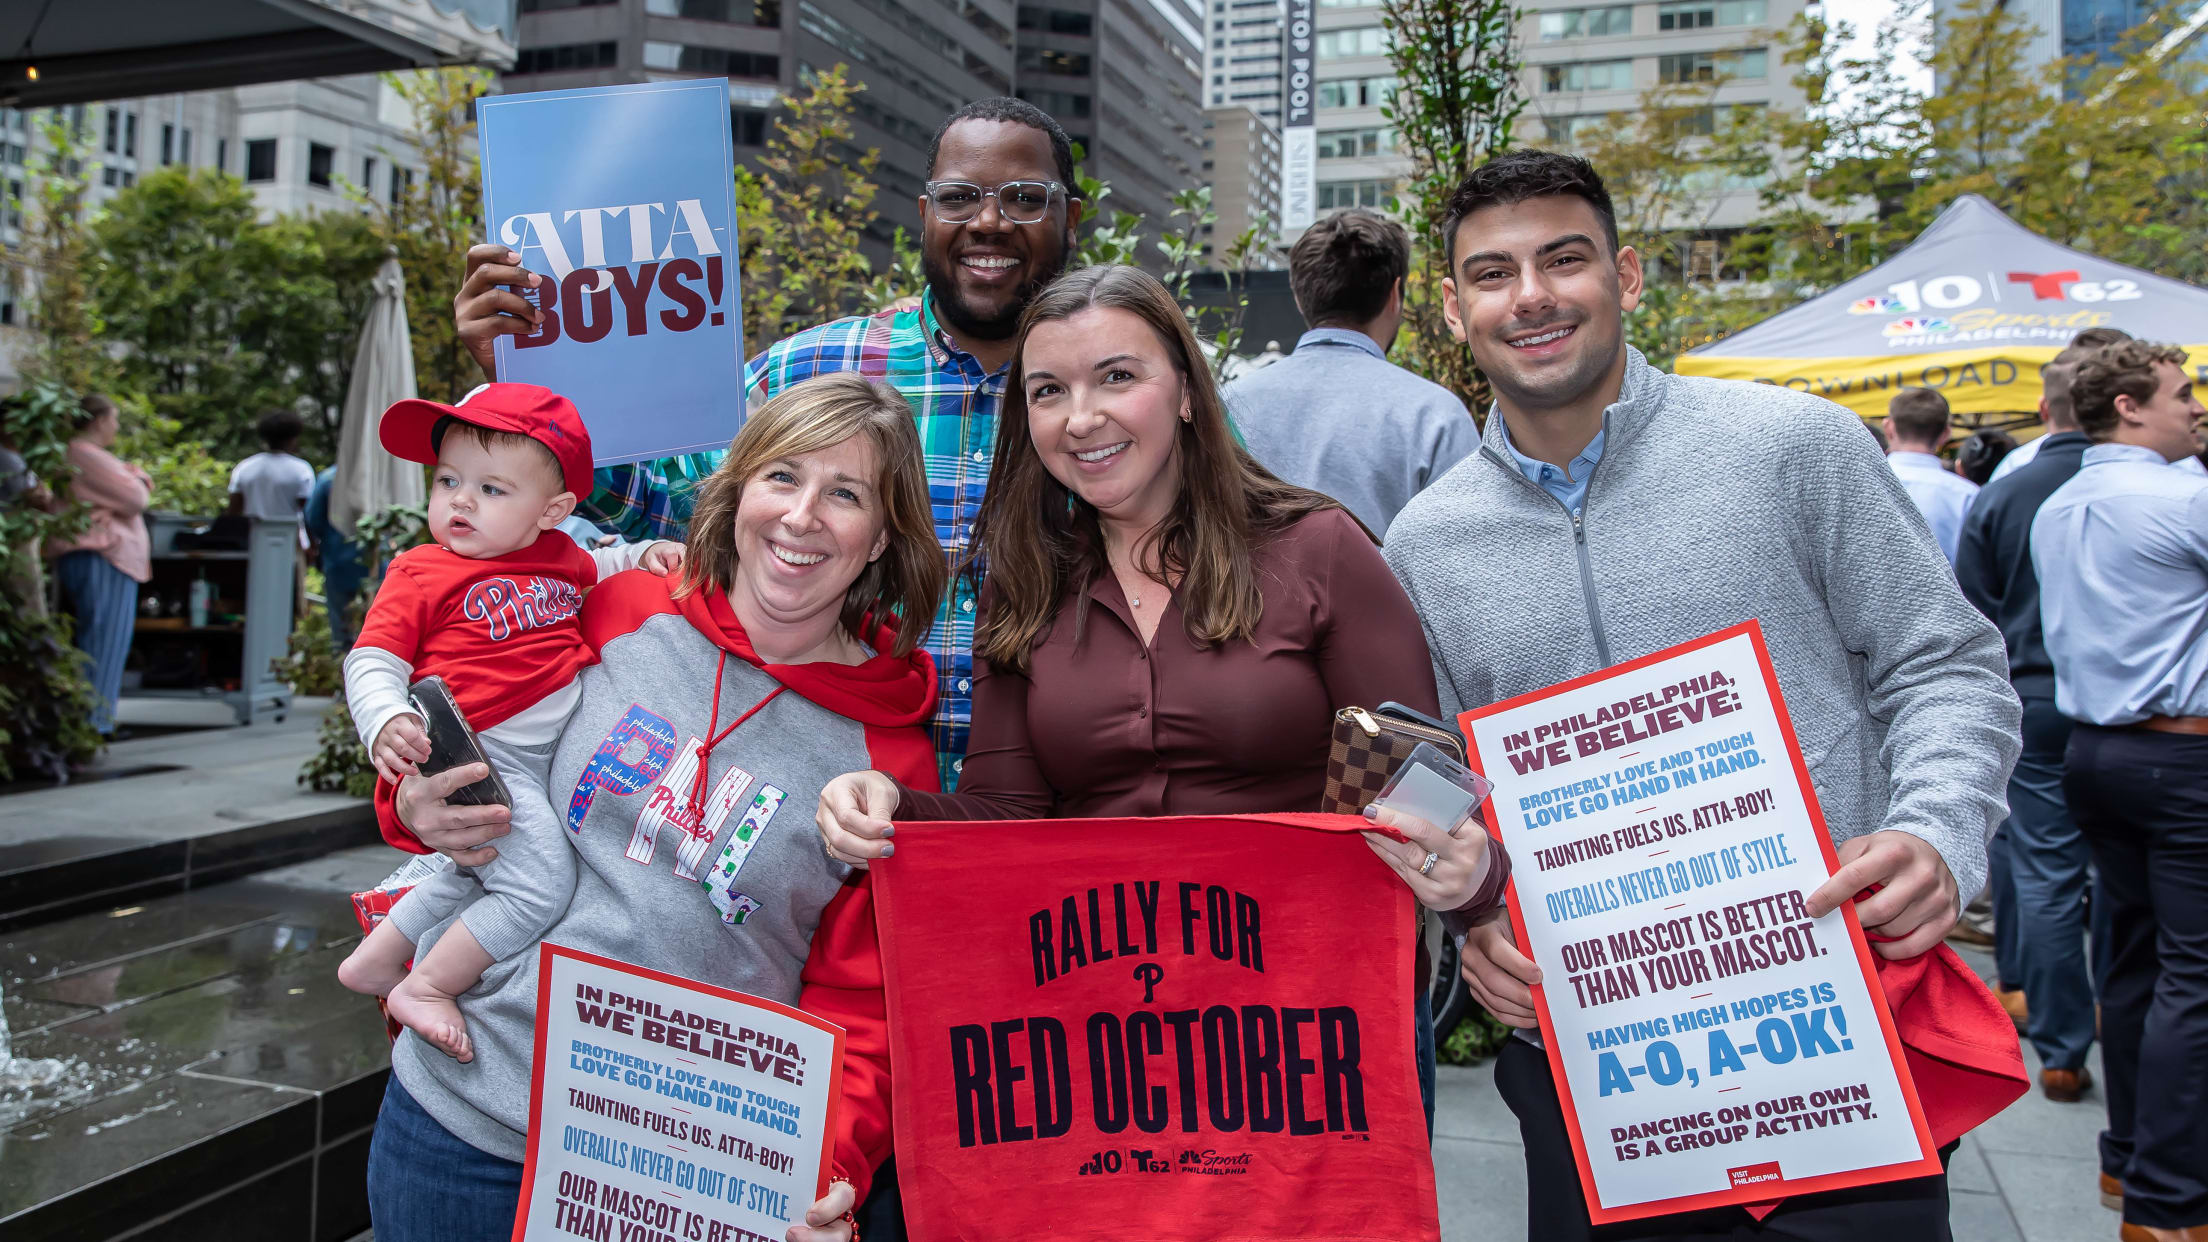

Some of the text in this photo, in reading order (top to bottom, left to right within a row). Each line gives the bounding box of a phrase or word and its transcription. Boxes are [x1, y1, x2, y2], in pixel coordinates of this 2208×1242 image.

[1290, 58, 1310, 122] POOL
[500, 200, 724, 294] ATTA-
[509, 256, 724, 349] BOYS!
[1888, 275, 1983, 312] 10
[1948, 308, 2112, 333] Sports
[1888, 328, 2079, 348] PHILADELPHI
[1502, 670, 1736, 752] IN PHILADELPHIA,
[1507, 689, 1743, 776] WE BELIEVE:
[1519, 731, 1755, 811] BROTHERLY LOVE AND TOUGH
[1523, 748, 1766, 830] LOVE GO HAND IN HAND.
[1534, 787, 1776, 872] TAUNTING FUELS US. ATTA-BOY!
[1545, 833, 1797, 923] OVERALLS NEVER GO OUT OF STYLE.
[1029, 880, 1265, 987] RALLY FOR
[1561, 889, 1811, 973] OUR MASCOT IS BETTER
[1568, 921, 1828, 1009] THAN YOUR MASCOT.
[576, 983, 807, 1065] IN PHILADELPHIA,
[1133, 962, 1164, 1004] P
[1586, 982, 1836, 1051] HAVING HIGH HOPES IS
[571, 1040, 801, 1119] BROTHERLY LOVE AND TOUGH
[575, 1000, 804, 1087] WE BELIEVE:
[949, 1005, 1369, 1148] RED OCTOBER
[1598, 1004, 1854, 1097] A-O, A-OK!
[568, 1087, 794, 1176] TAUNTING FUELS US. ATTA-BOY!
[570, 1053, 802, 1139] LOVE GO HAND IN HAND.
[1610, 1083, 1871, 1143] DANCING ON OUR OWN
[1614, 1102, 1878, 1162] IS A GROUP ACTIVITY.
[563, 1124, 791, 1222] OVERALLS NEVER GO OUT OF STYLE.
[1092, 1150, 1122, 1175] 10
[1201, 1150, 1253, 1168] Sports
[1181, 1166, 1247, 1176] PHILADELPHIA
[1731, 1170, 1748, 1178] VISIT
[1733, 1172, 1779, 1186] PHILADELPHIA
[555, 1198, 677, 1242] THAN YO
[558, 1170, 598, 1207] OUR
[600, 1183, 682, 1234] MASCOT
[683, 1211, 704, 1242] IS
